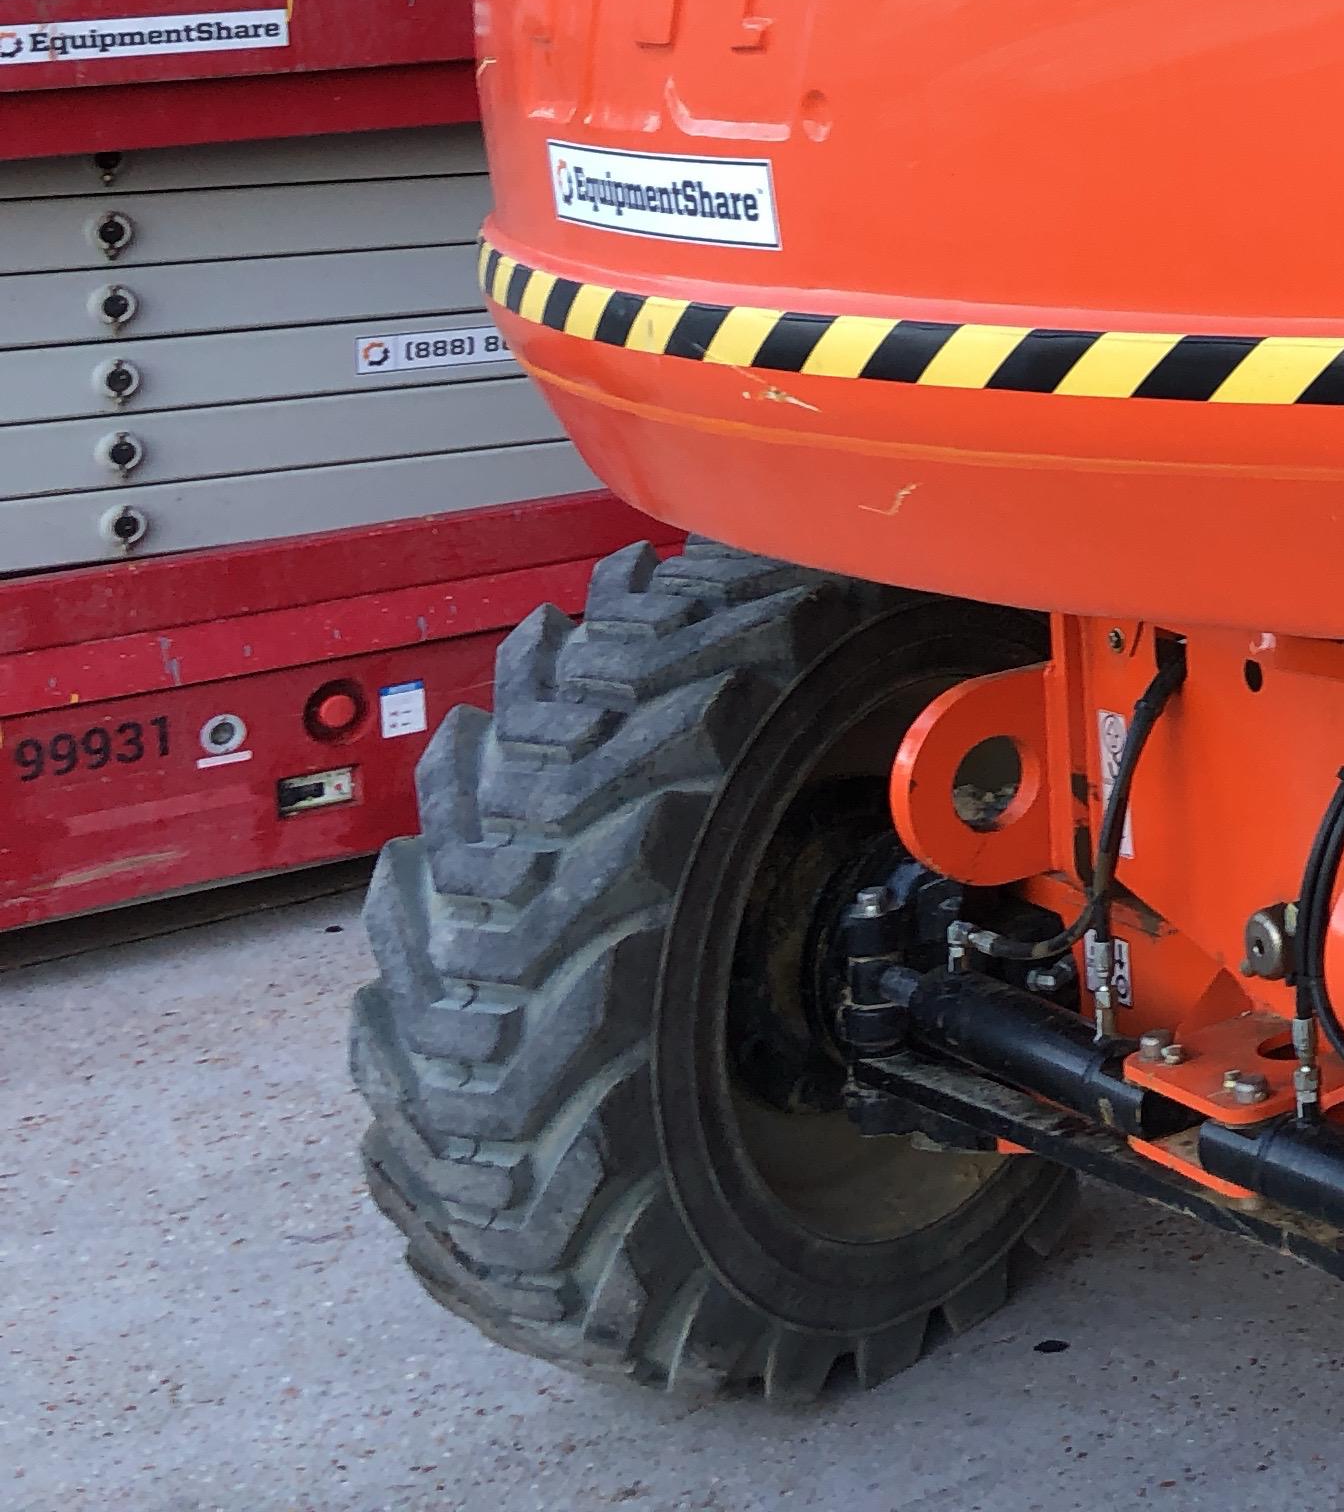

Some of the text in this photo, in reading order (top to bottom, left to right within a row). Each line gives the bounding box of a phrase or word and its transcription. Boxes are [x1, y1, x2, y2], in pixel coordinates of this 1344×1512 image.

[30, 21, 281, 54] EquipmentShare
[573, 166, 760, 222] EquipmentShare
[405, 336, 475, 361] (888)
[15, 716, 171, 782] 99931
